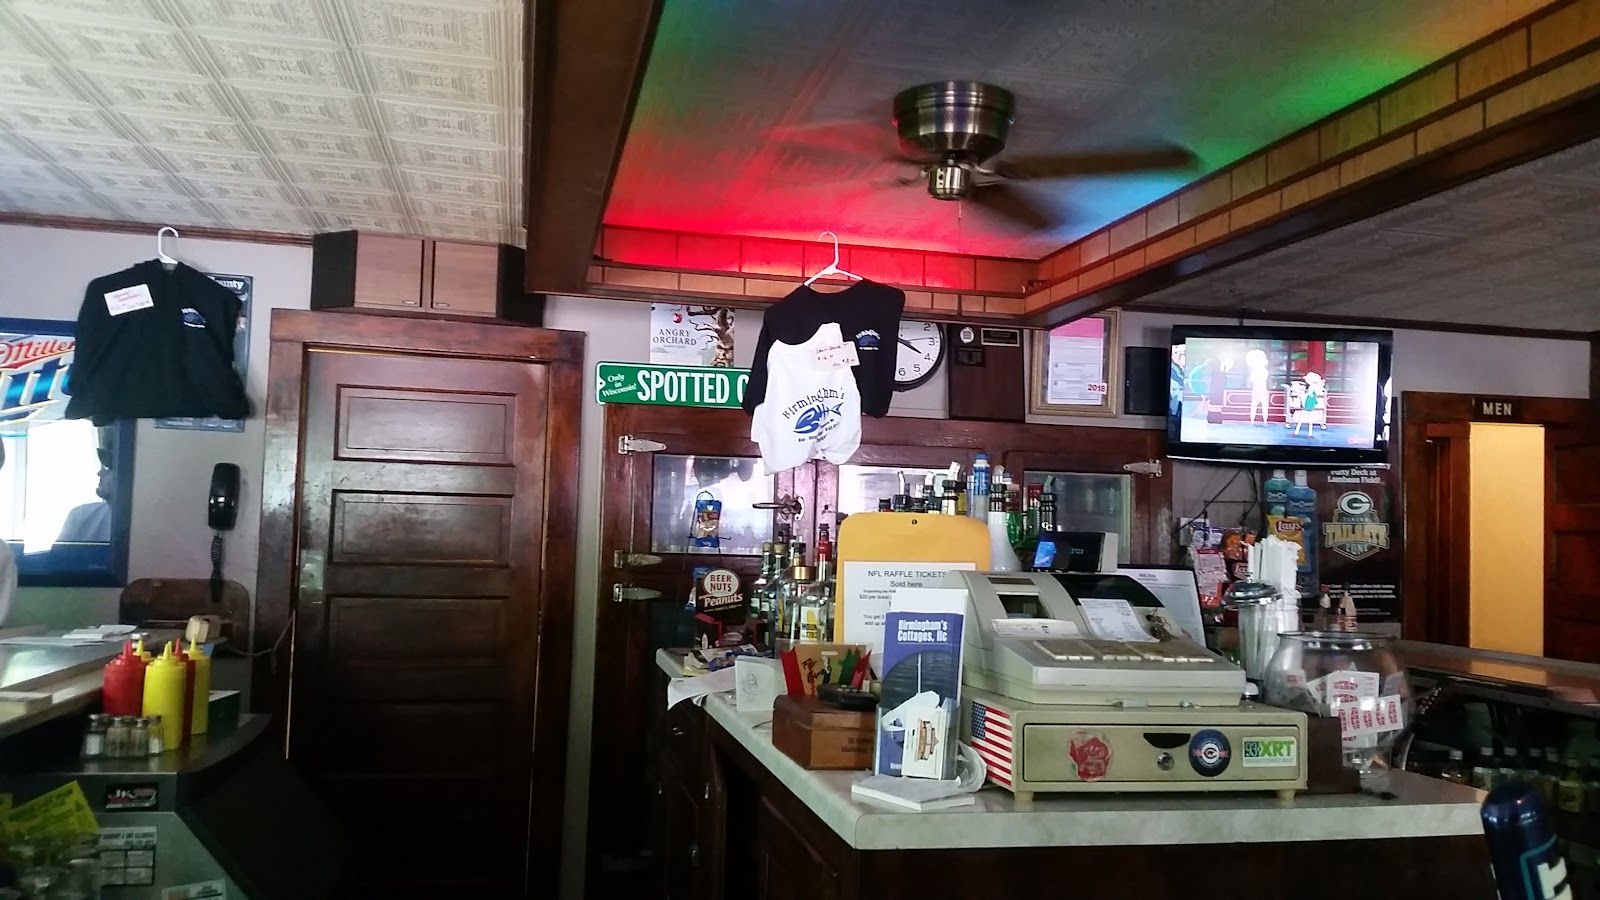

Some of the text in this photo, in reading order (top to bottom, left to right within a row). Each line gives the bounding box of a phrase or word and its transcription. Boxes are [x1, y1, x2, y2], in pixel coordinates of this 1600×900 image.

[659, 328, 691, 337] ANGRY
[653, 336, 697, 346] ORCHARD
[898, 367, 906, 376] 6
[913, 364, 921, 373] 5
[637, 369, 730, 404] SPOTTED
[1087, 383, 1106, 393] 2018
[1482, 401, 1512, 416] MEN
[710, 583, 732, 592] NUTS
[703, 593, 743, 608] Peanuts
[898, 619, 948, 631] Birmingham's
[897, 630, 935, 642] Cottages,
